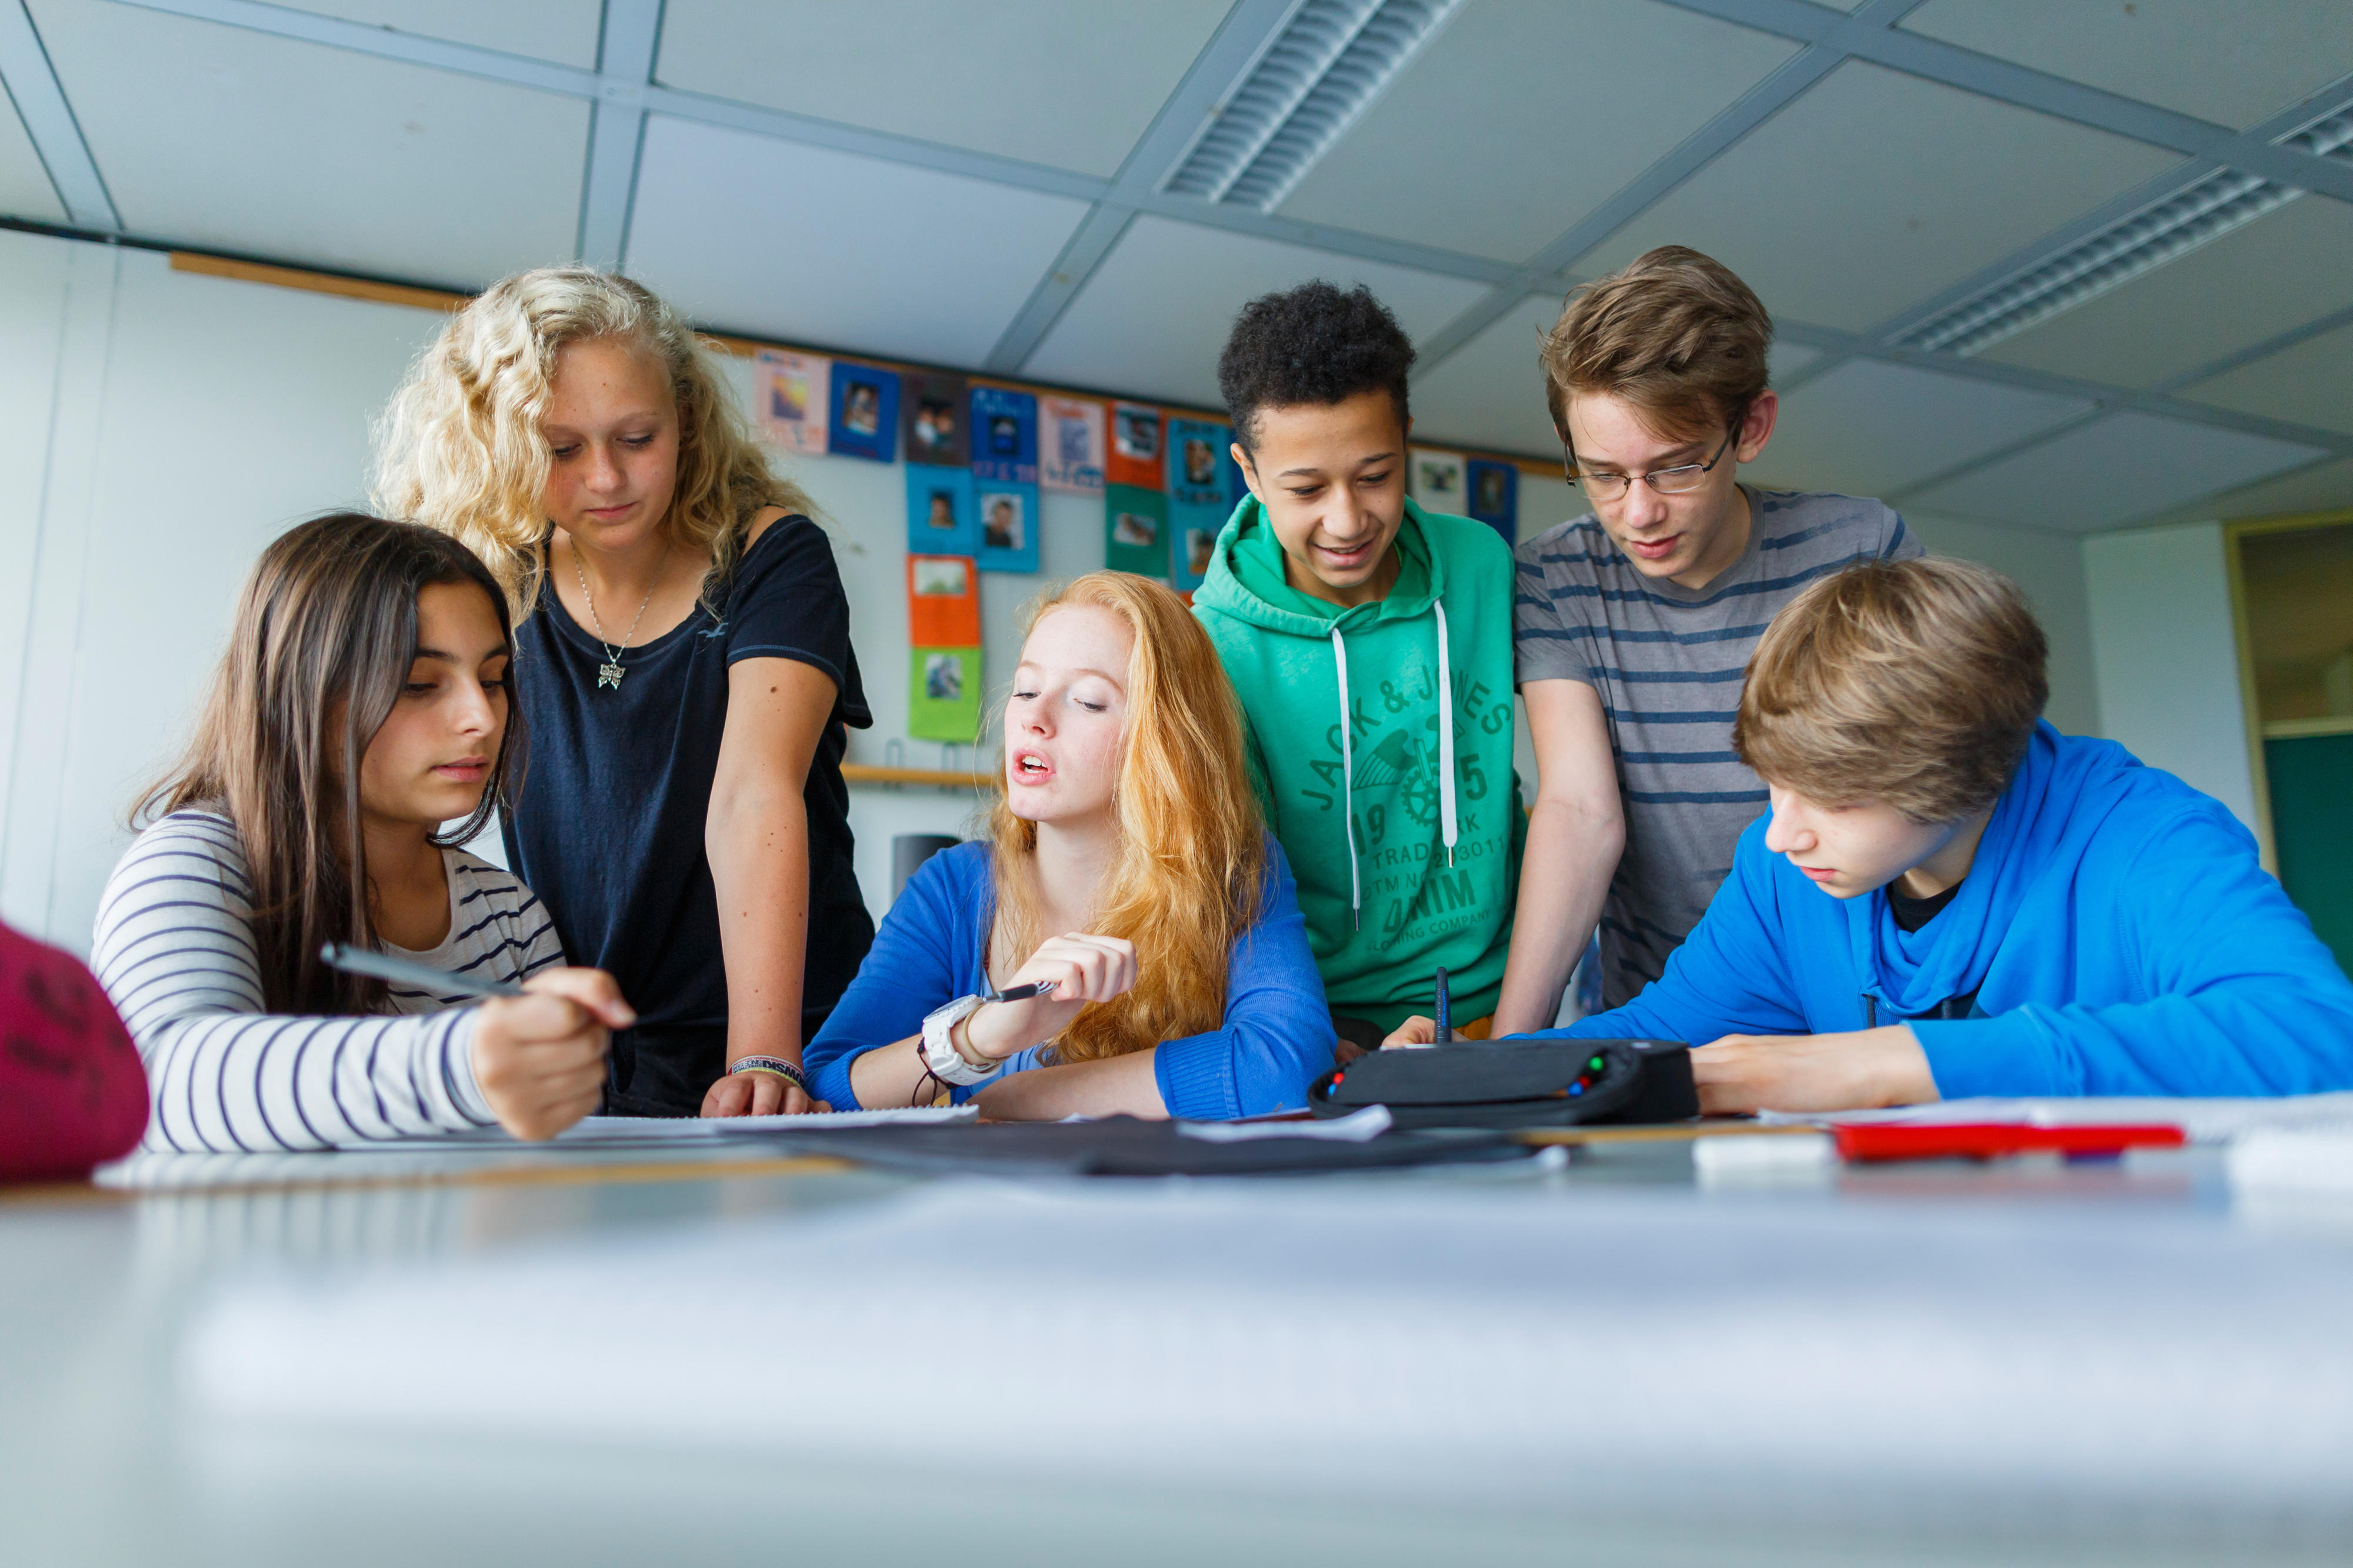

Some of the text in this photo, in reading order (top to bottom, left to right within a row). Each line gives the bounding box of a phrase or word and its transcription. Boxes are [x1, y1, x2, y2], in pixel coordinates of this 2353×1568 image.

[1302, 665, 1511, 812] JACK & JONES
[1352, 803, 1385, 856] 19
[1429, 908, 1491, 934] COMPANY
